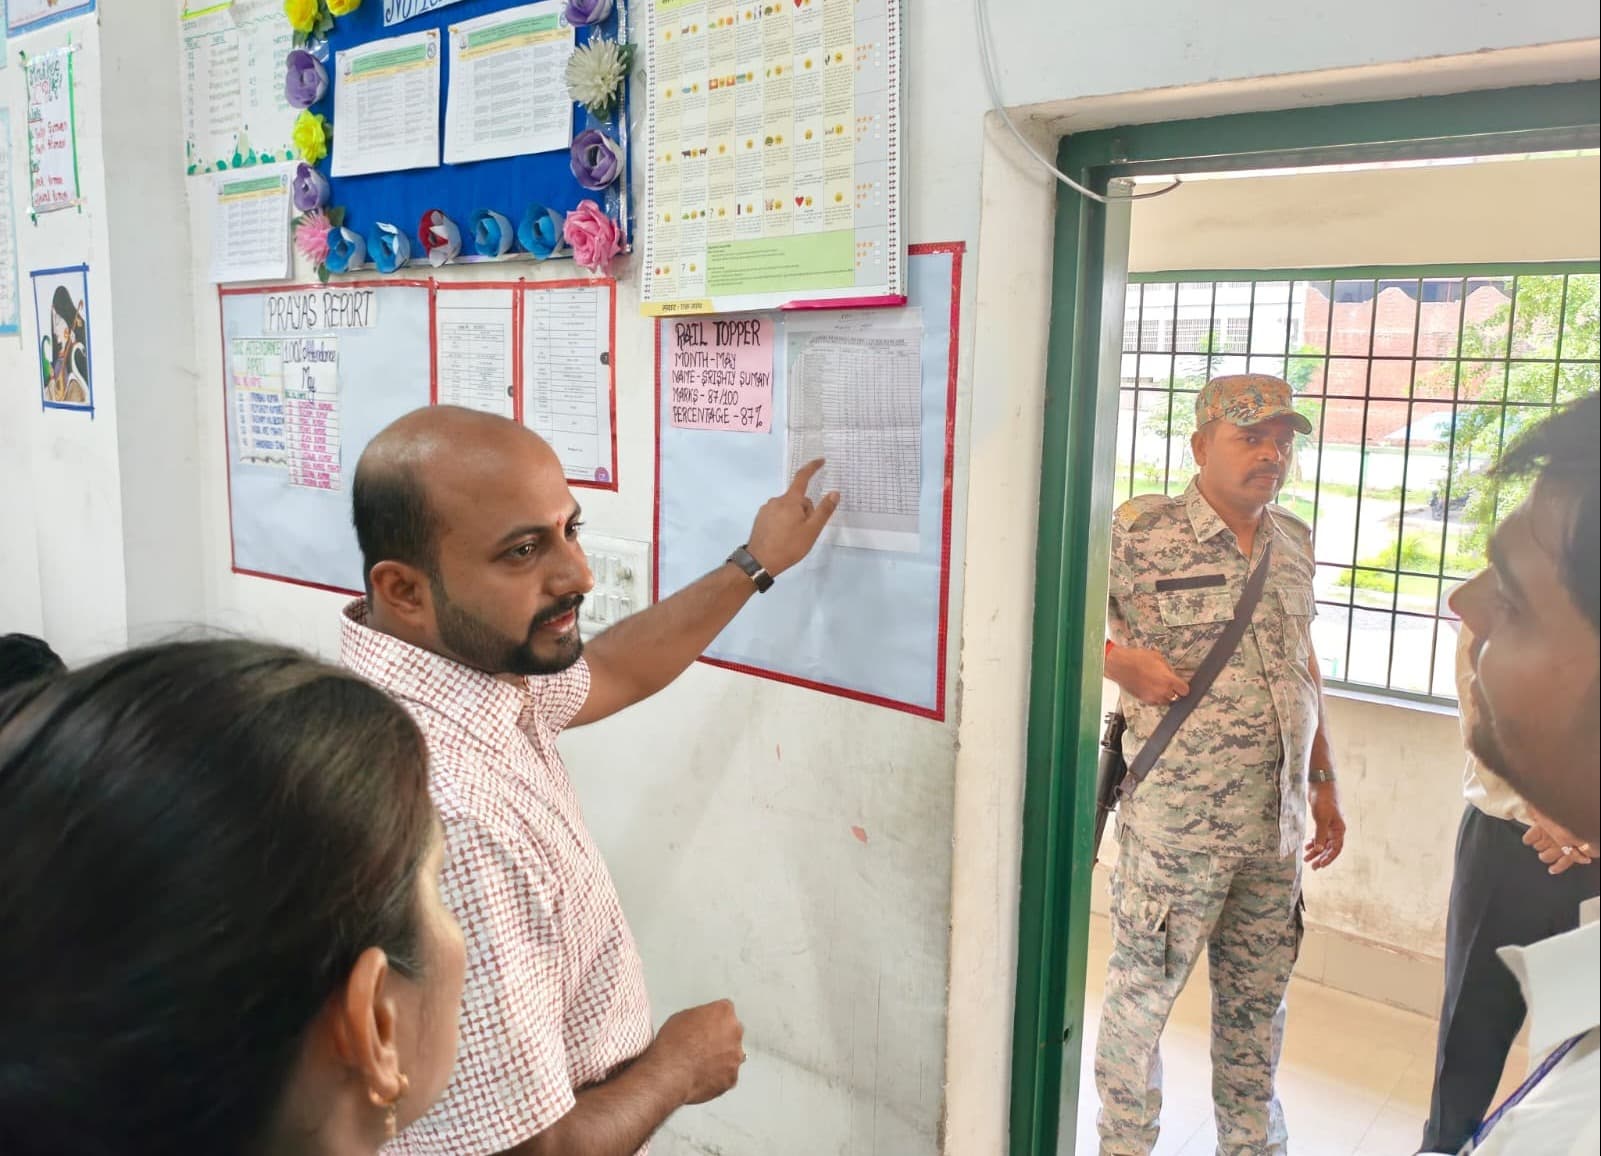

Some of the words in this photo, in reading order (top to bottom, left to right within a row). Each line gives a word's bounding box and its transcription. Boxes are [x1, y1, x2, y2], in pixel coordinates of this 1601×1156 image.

[268, 293, 317, 330] PRAYAS
[323, 290, 374, 328] REPORT
[675, 321, 708, 350] RAIL
[713, 319, 761, 347] TOPPER
[740, 371, 770, 387] SUMAN
[708, 388, 739, 406] 87/100
[673, 405, 730, 424] PERCENTAGE
